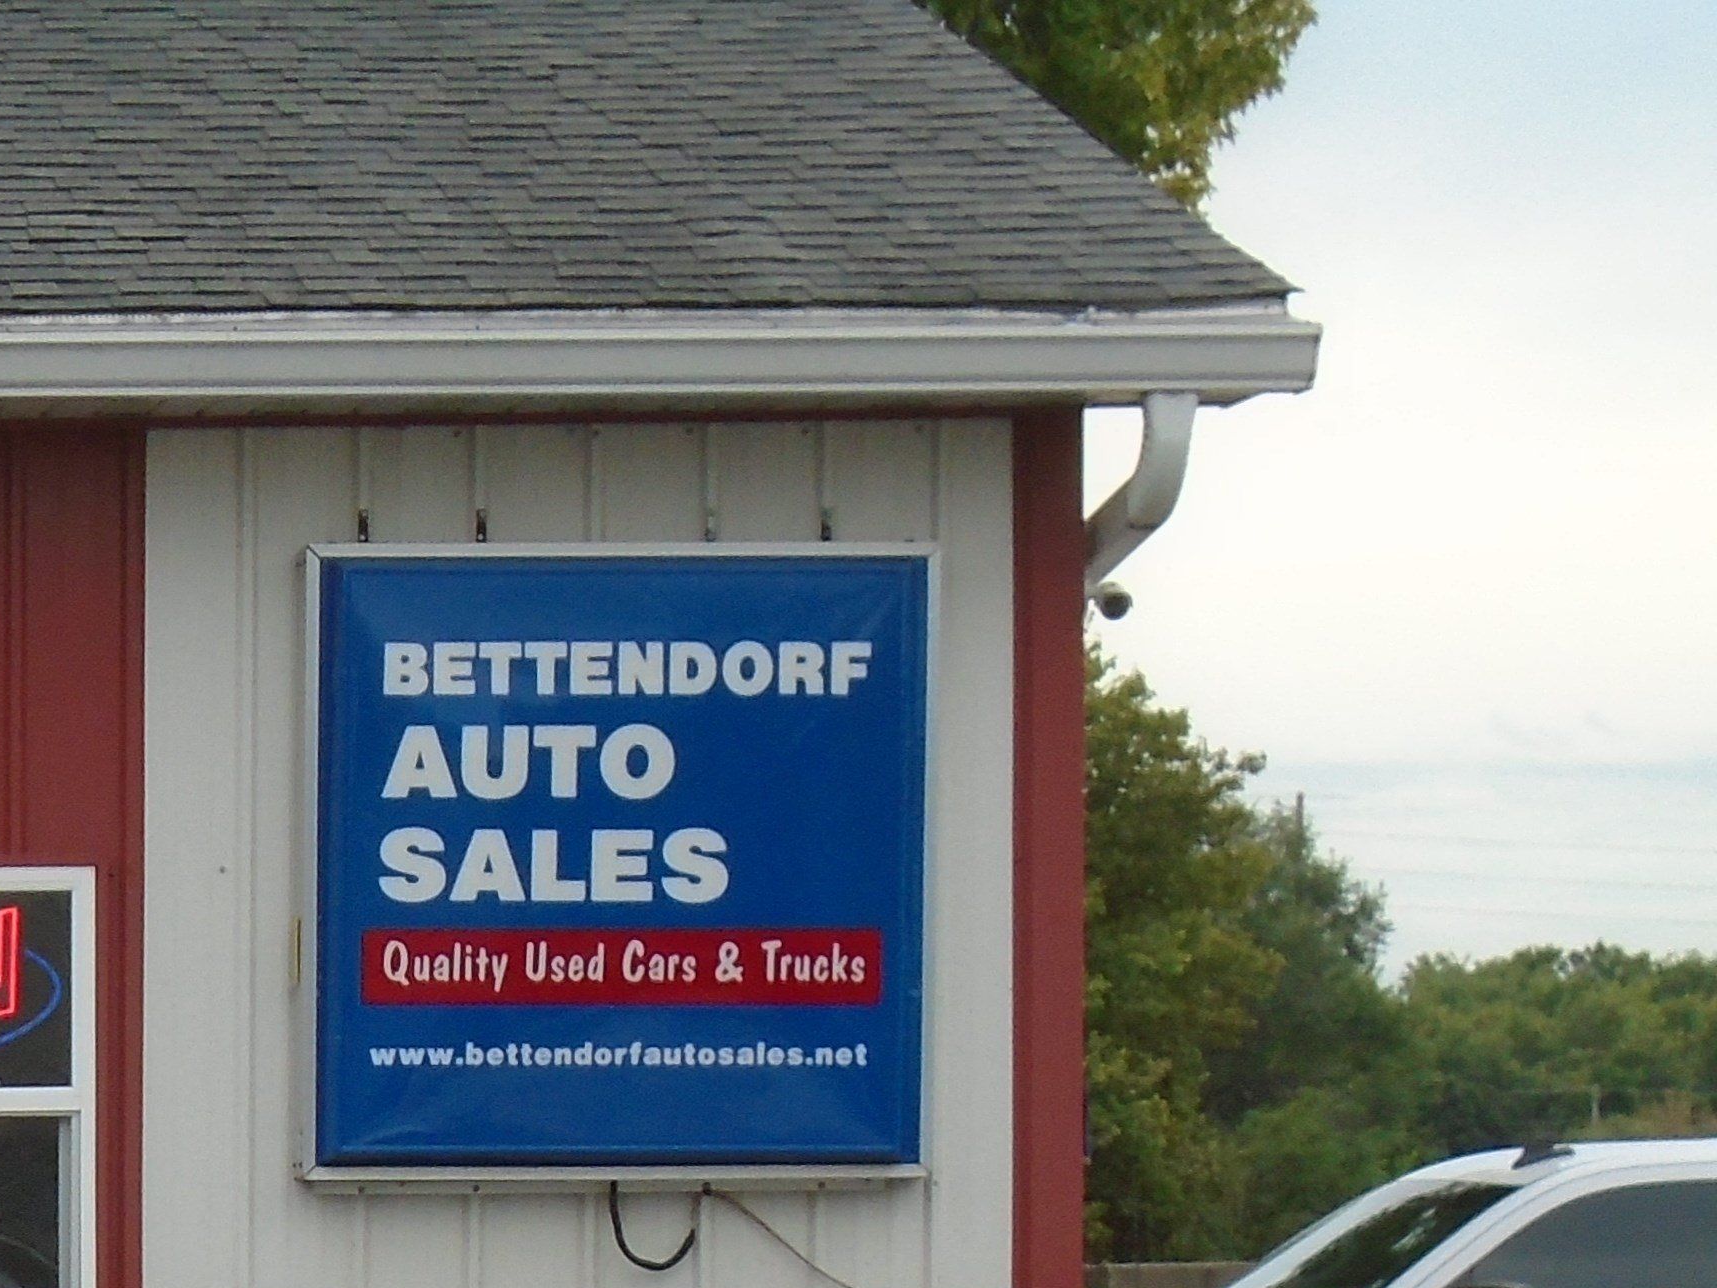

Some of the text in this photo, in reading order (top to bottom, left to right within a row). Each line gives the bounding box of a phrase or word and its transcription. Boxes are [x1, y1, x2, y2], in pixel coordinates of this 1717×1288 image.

[382, 640, 873, 697] BETTENDORF
[380, 723, 676, 800] AUTO
[378, 826, 730, 904] SALES
[382, 938, 866, 992] Quality Used Cars & Trucks
[369, 1040, 868, 1067] www.bettendorfautosales.net
